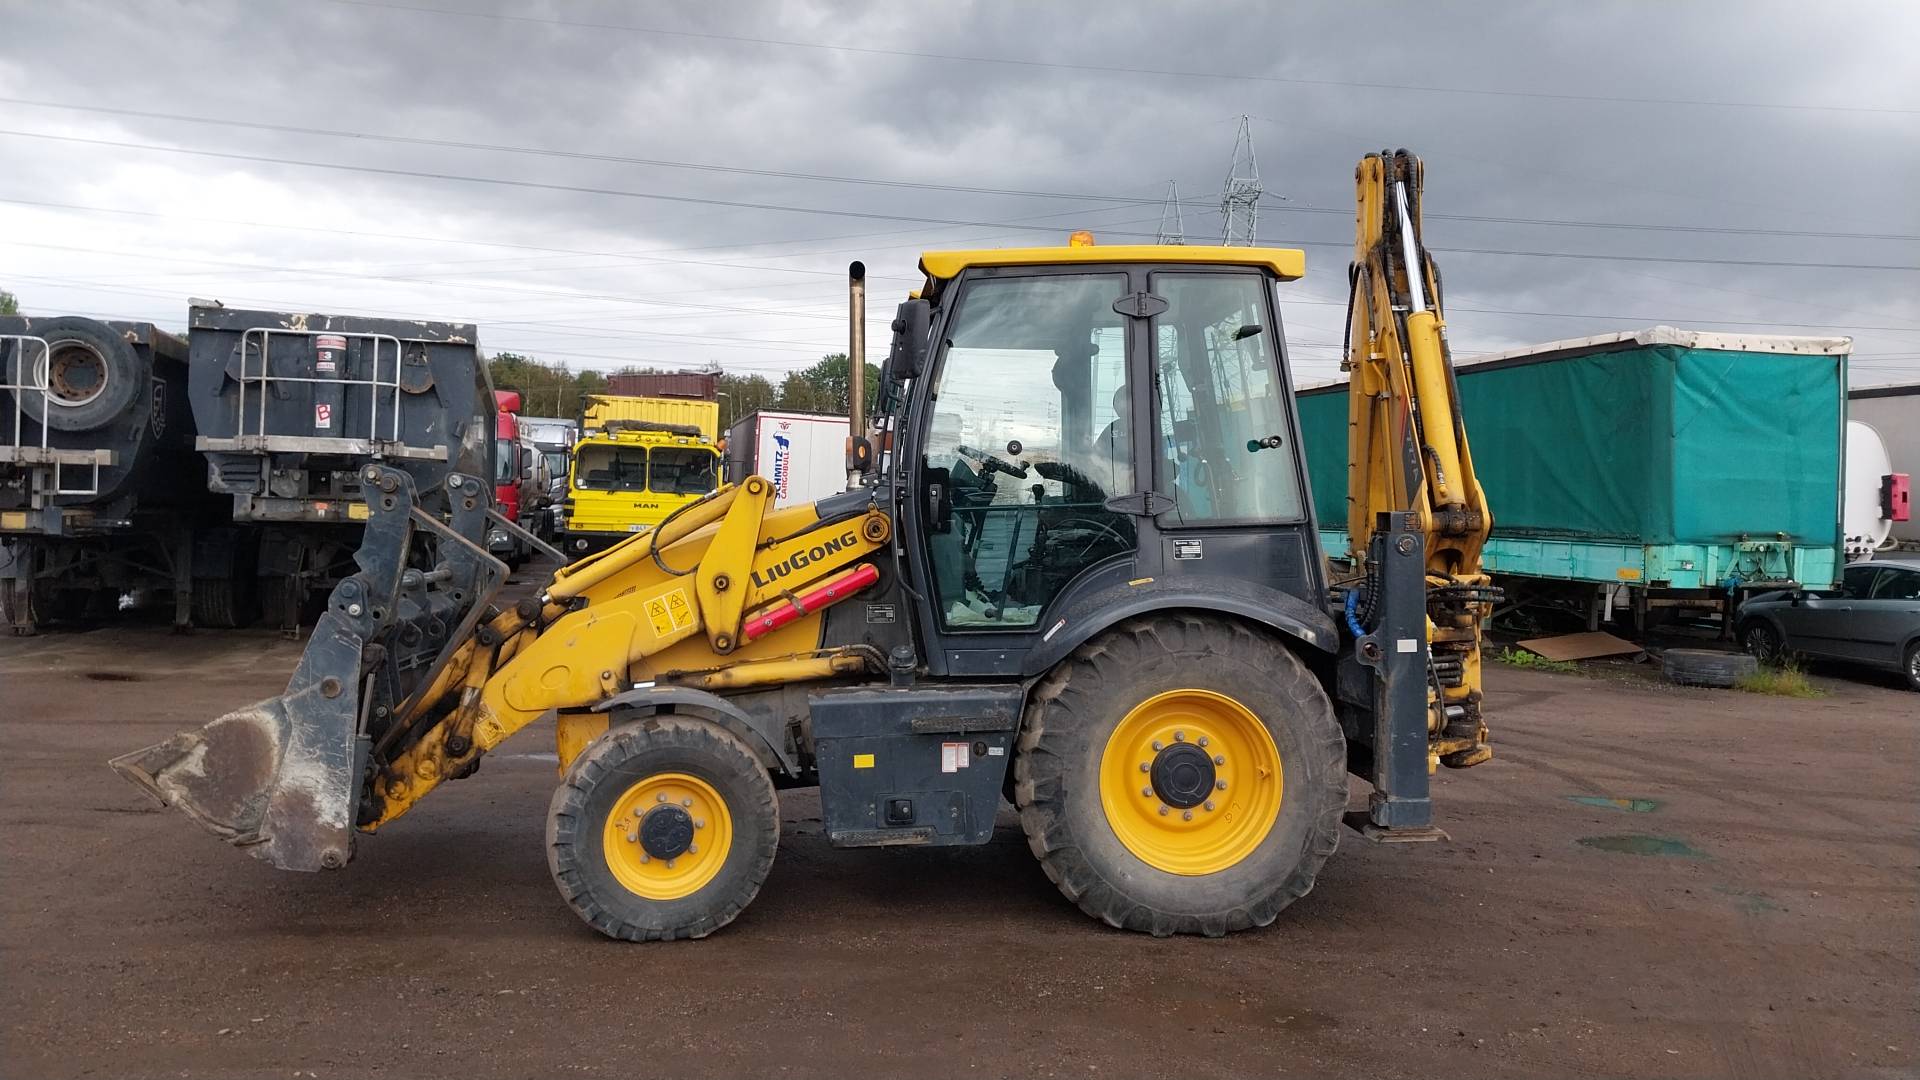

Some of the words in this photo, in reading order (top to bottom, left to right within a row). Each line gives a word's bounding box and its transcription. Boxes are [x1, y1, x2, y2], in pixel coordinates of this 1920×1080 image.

[317, 405, 331, 421] B
[774, 450, 783, 499] SCHMITZ
[781, 451, 790, 500] CARGOBULL
